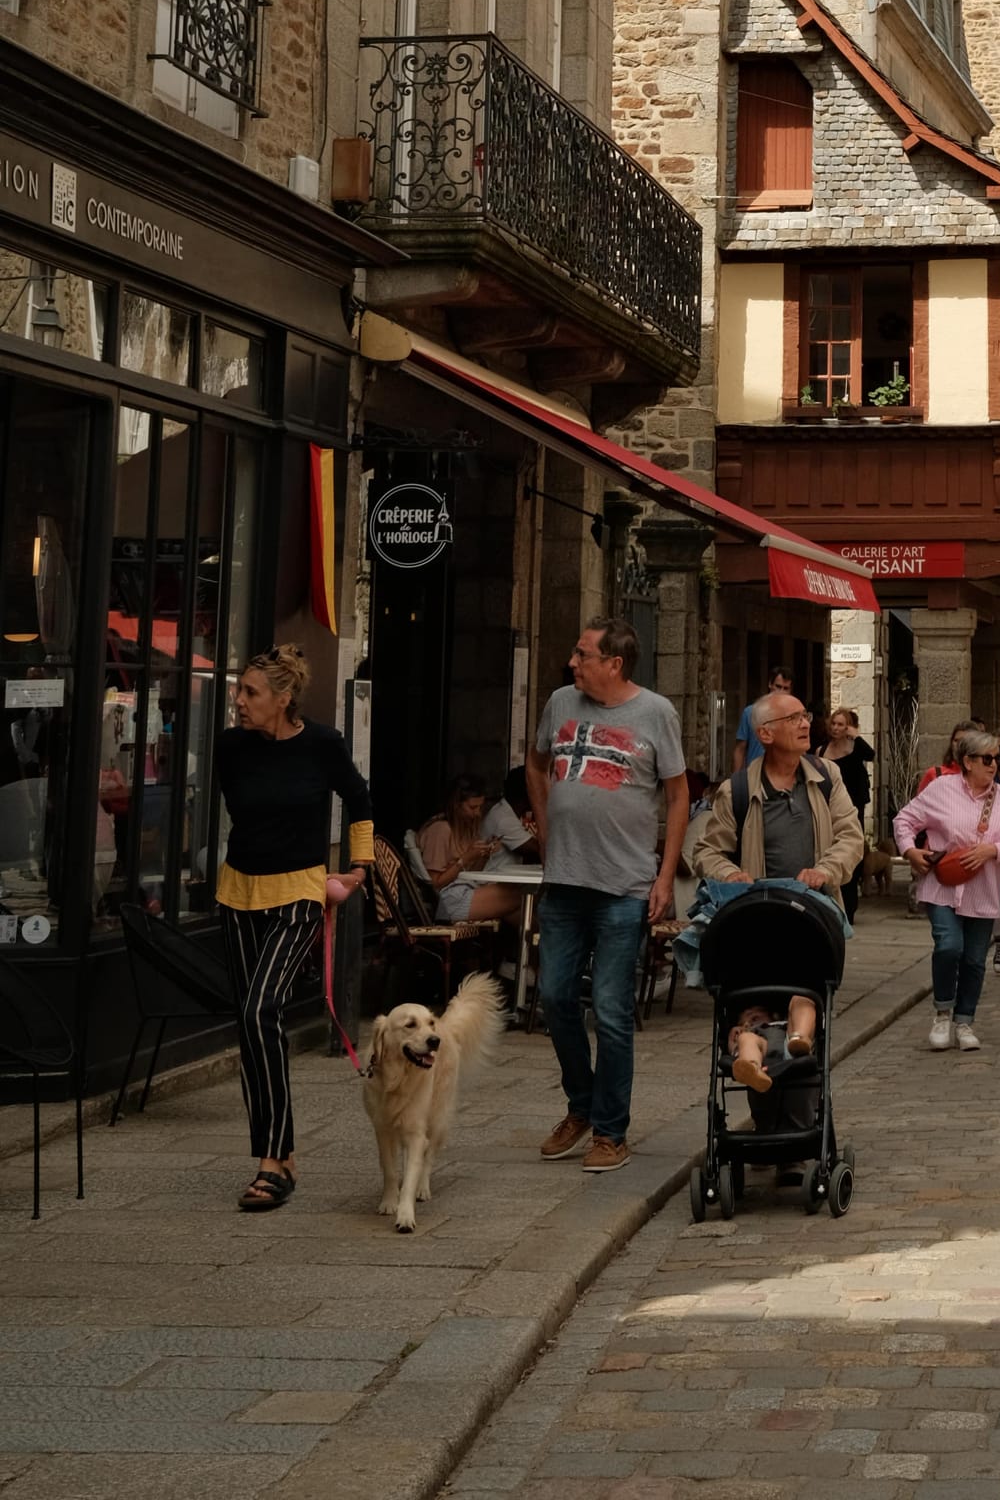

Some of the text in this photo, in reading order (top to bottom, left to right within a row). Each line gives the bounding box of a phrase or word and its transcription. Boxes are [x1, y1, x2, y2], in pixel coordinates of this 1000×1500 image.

[0, 160, 39, 200] ION
[87, 198, 184, 260] CONTEMPORAINE
[378, 506, 435, 524] CRÊPERIE
[400, 523, 412, 531] de
[378, 531, 433, 544] L'HORLOGE
[841, 546, 926, 558] GALERIE D'ART
[863, 559, 926, 574] GISANT
